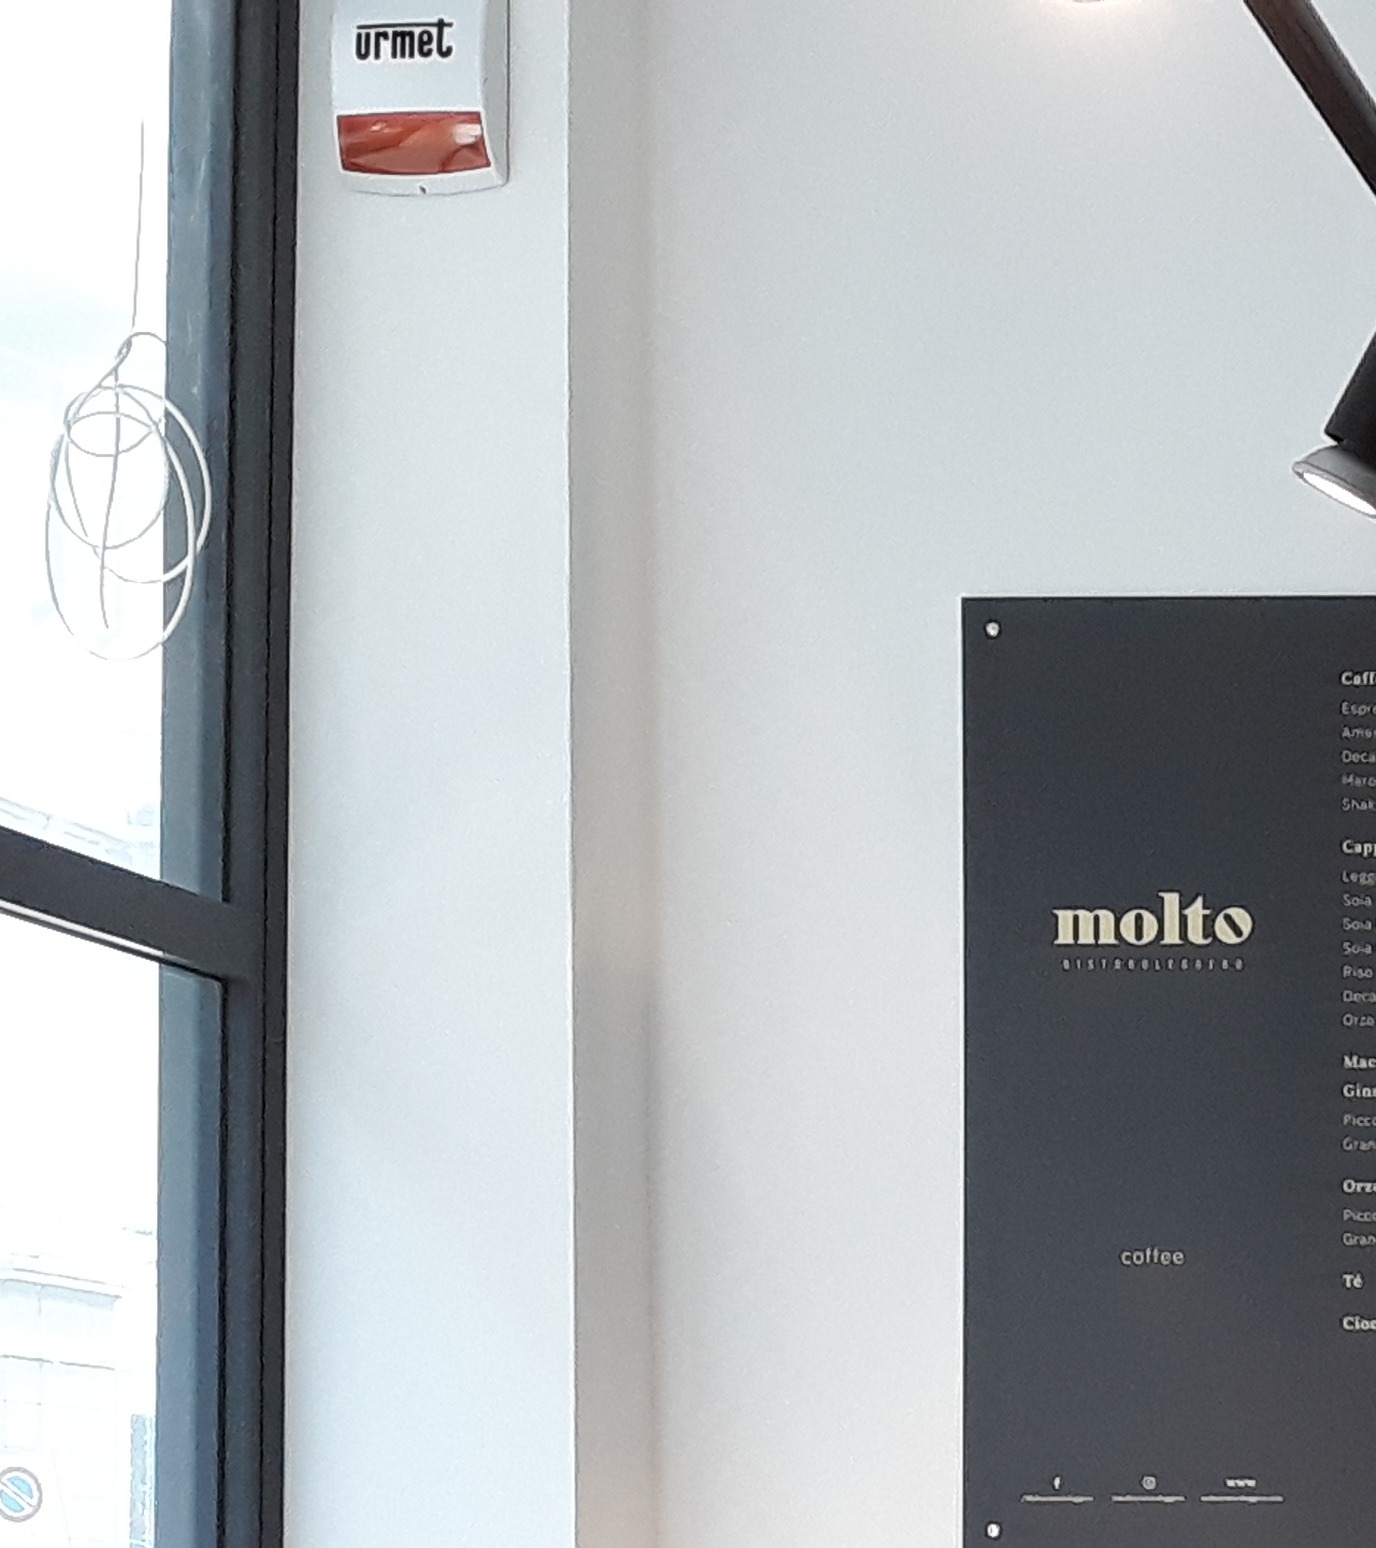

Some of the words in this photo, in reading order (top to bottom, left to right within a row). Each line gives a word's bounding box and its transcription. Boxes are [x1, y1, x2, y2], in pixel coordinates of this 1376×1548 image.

[355, 18, 454, 60] urmet
[1053, 893, 1252, 945] molto
[1121, 1247, 1184, 1265] coffee
